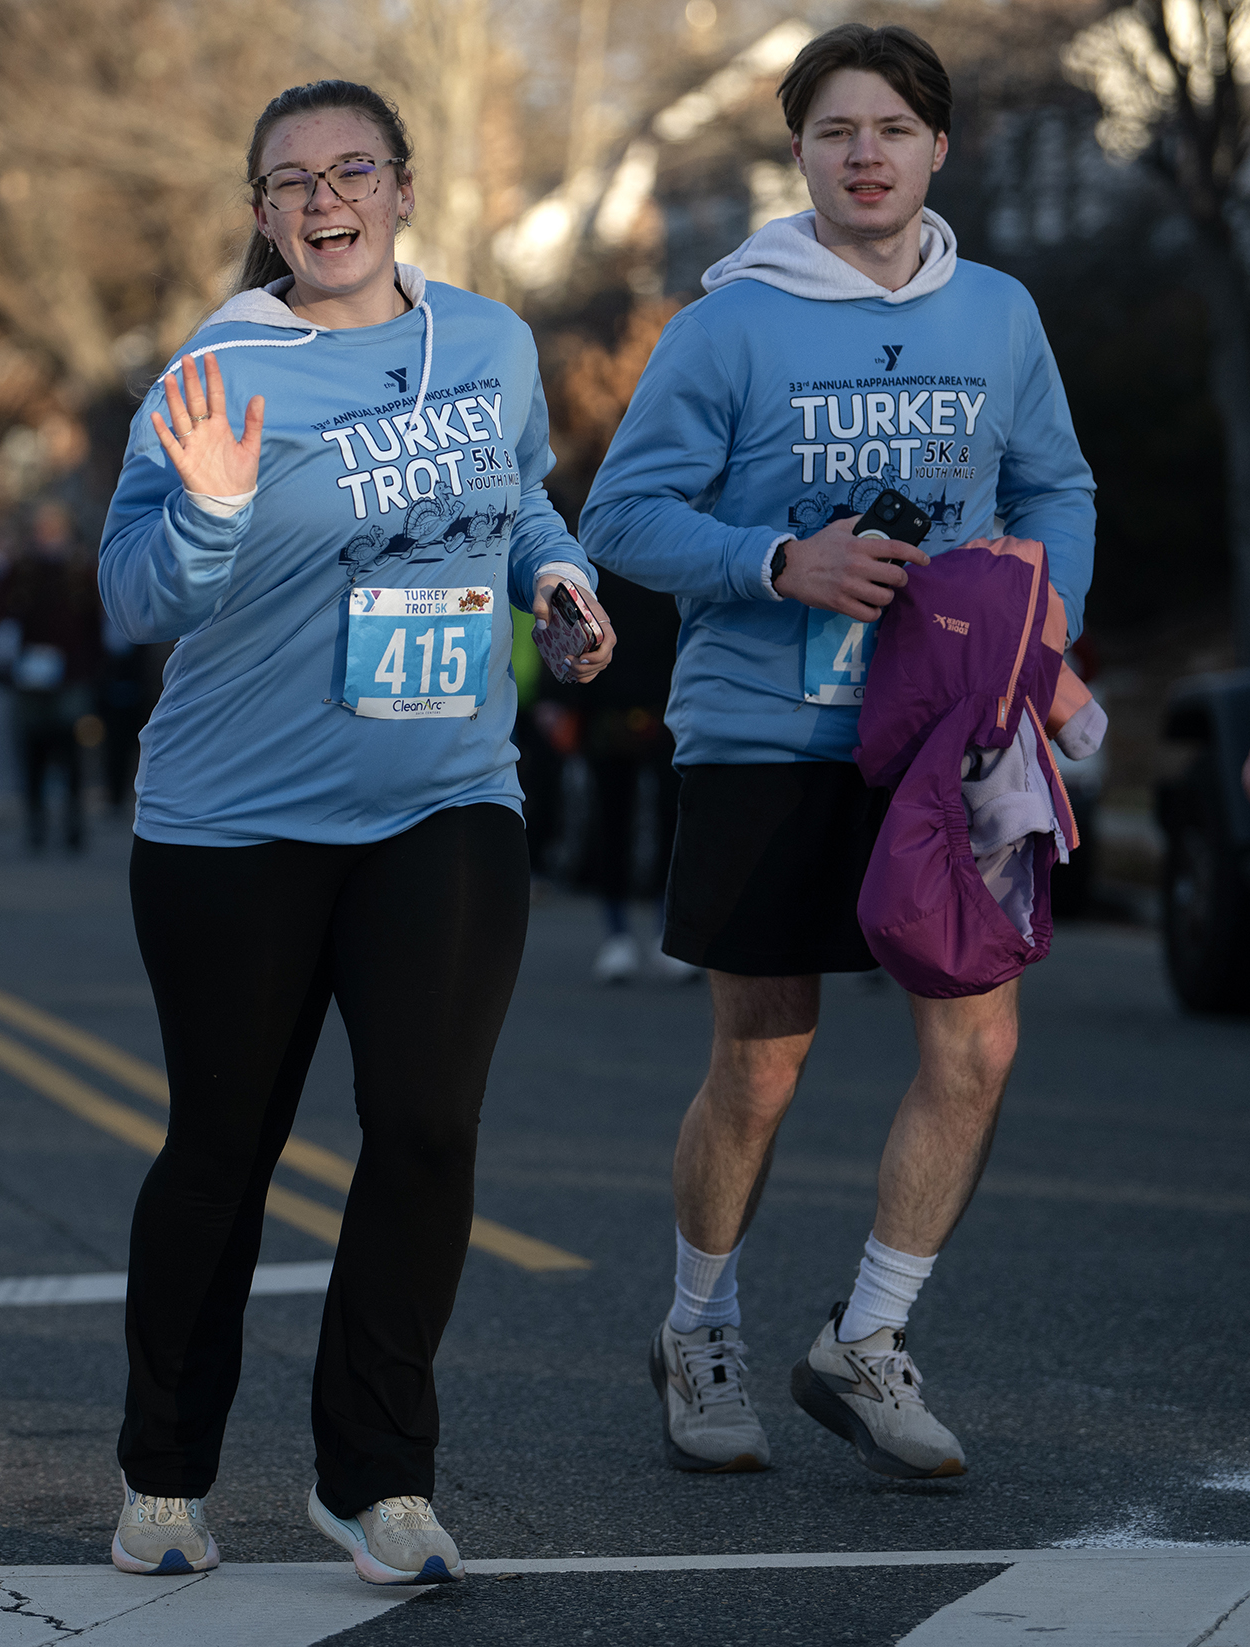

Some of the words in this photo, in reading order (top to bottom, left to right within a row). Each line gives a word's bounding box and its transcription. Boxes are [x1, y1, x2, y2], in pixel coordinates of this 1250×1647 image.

[789, 381, 810, 393] 33rd
[812, 379, 855, 391] ANNUAL
[856, 375, 937, 389] RAPPAHANNOCK
[938, 375, 963, 386] AREA
[963, 376, 987, 387] YMCA
[333, 408, 376, 426] ANNUAL
[374, 388, 454, 415] RAPPAHNNOCK
[454, 381, 478, 395] AREA
[477, 378, 501, 390] YMCA
[790, 389, 987, 441] TURKEY
[321, 392, 504, 471] TURKEY
[791, 438, 922, 485] TROT
[922, 438, 955, 465] 5K
[957, 444, 970, 464] &
[915, 465, 948, 479] YOUTH
[952, 465, 977, 479] MILE
[336, 449, 465, 519] TROT
[471, 445, 503, 473] 5K
[503, 448, 513, 470] &
[465, 473, 504, 492] YOUTH
[404, 589, 448, 601] TURKEY
[405, 603, 433, 614] TROT
[435, 602, 448, 614] 5K
[374, 626, 467, 695] 415
[392, 698, 442, 712] CleanArc
